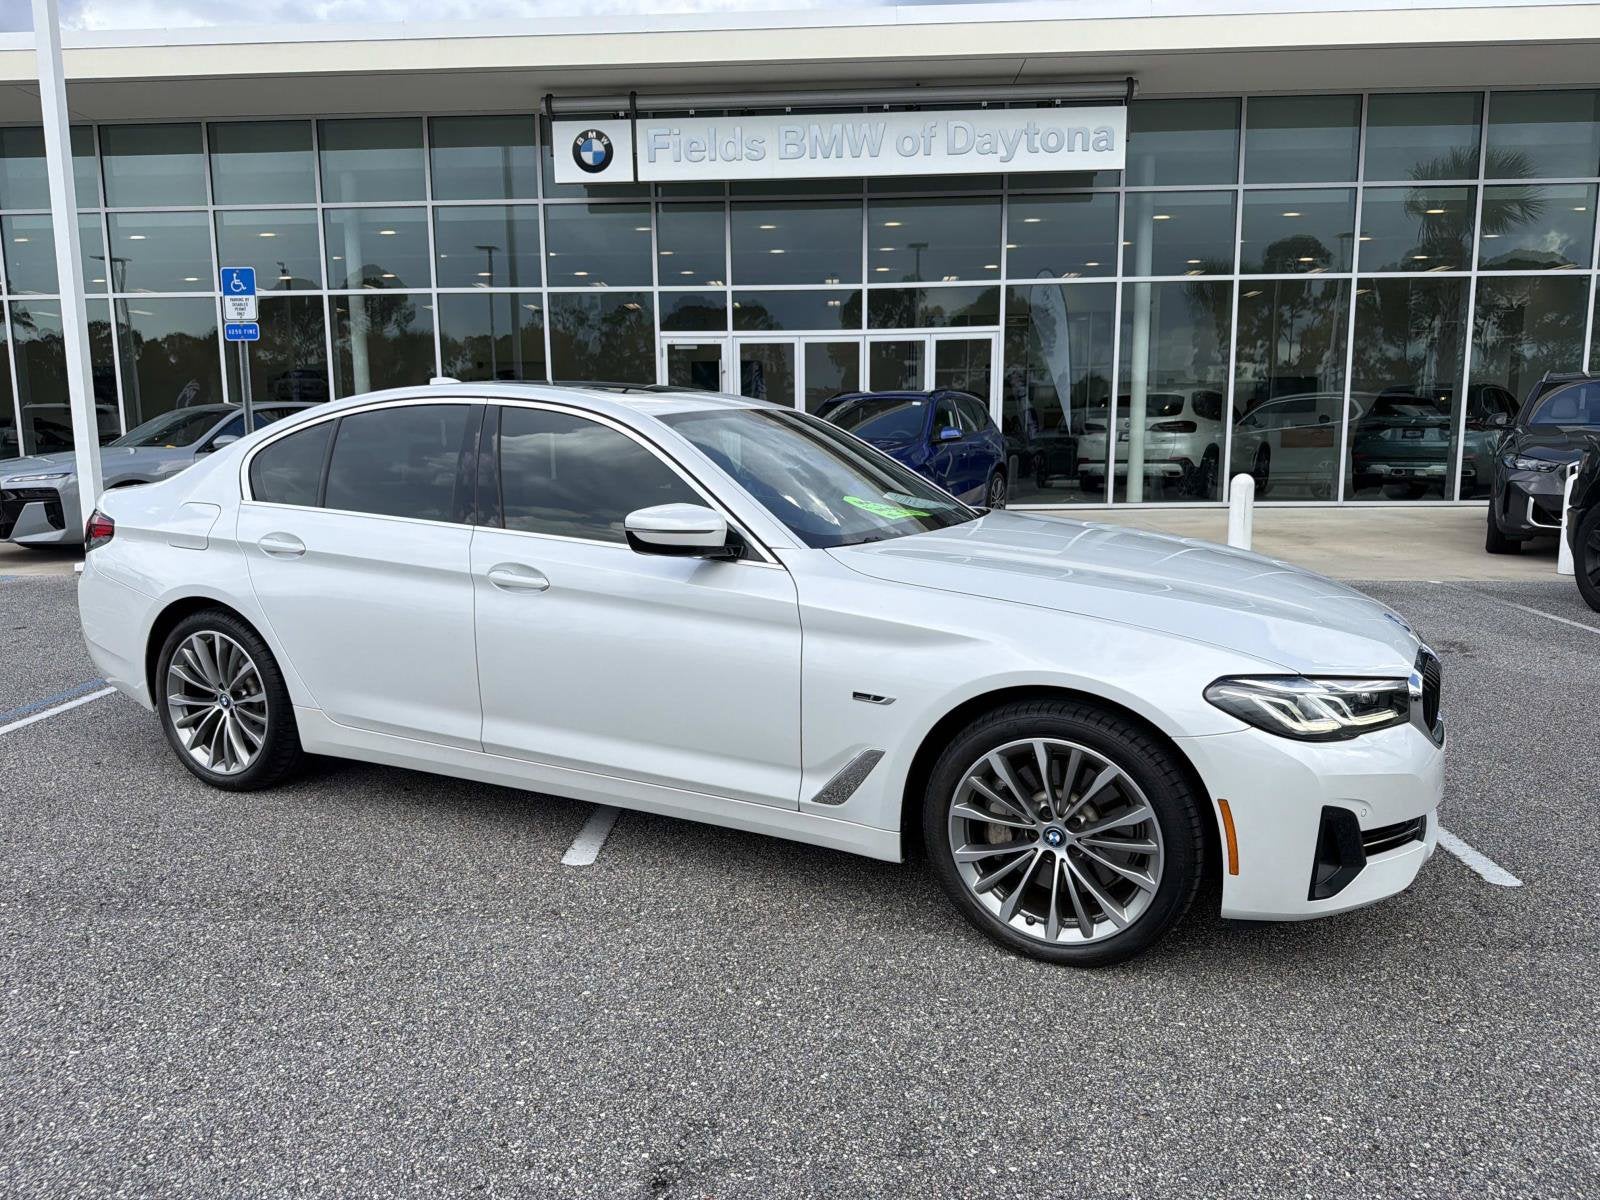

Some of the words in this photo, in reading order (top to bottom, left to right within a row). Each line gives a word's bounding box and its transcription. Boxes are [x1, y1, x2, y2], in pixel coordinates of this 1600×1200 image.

[576, 131, 609, 146] BMW
[646, 126, 767, 163] Fields
[778, 122, 886, 160] BMW
[895, 122, 937, 157] of
[946, 120, 1115, 163] Daytona
